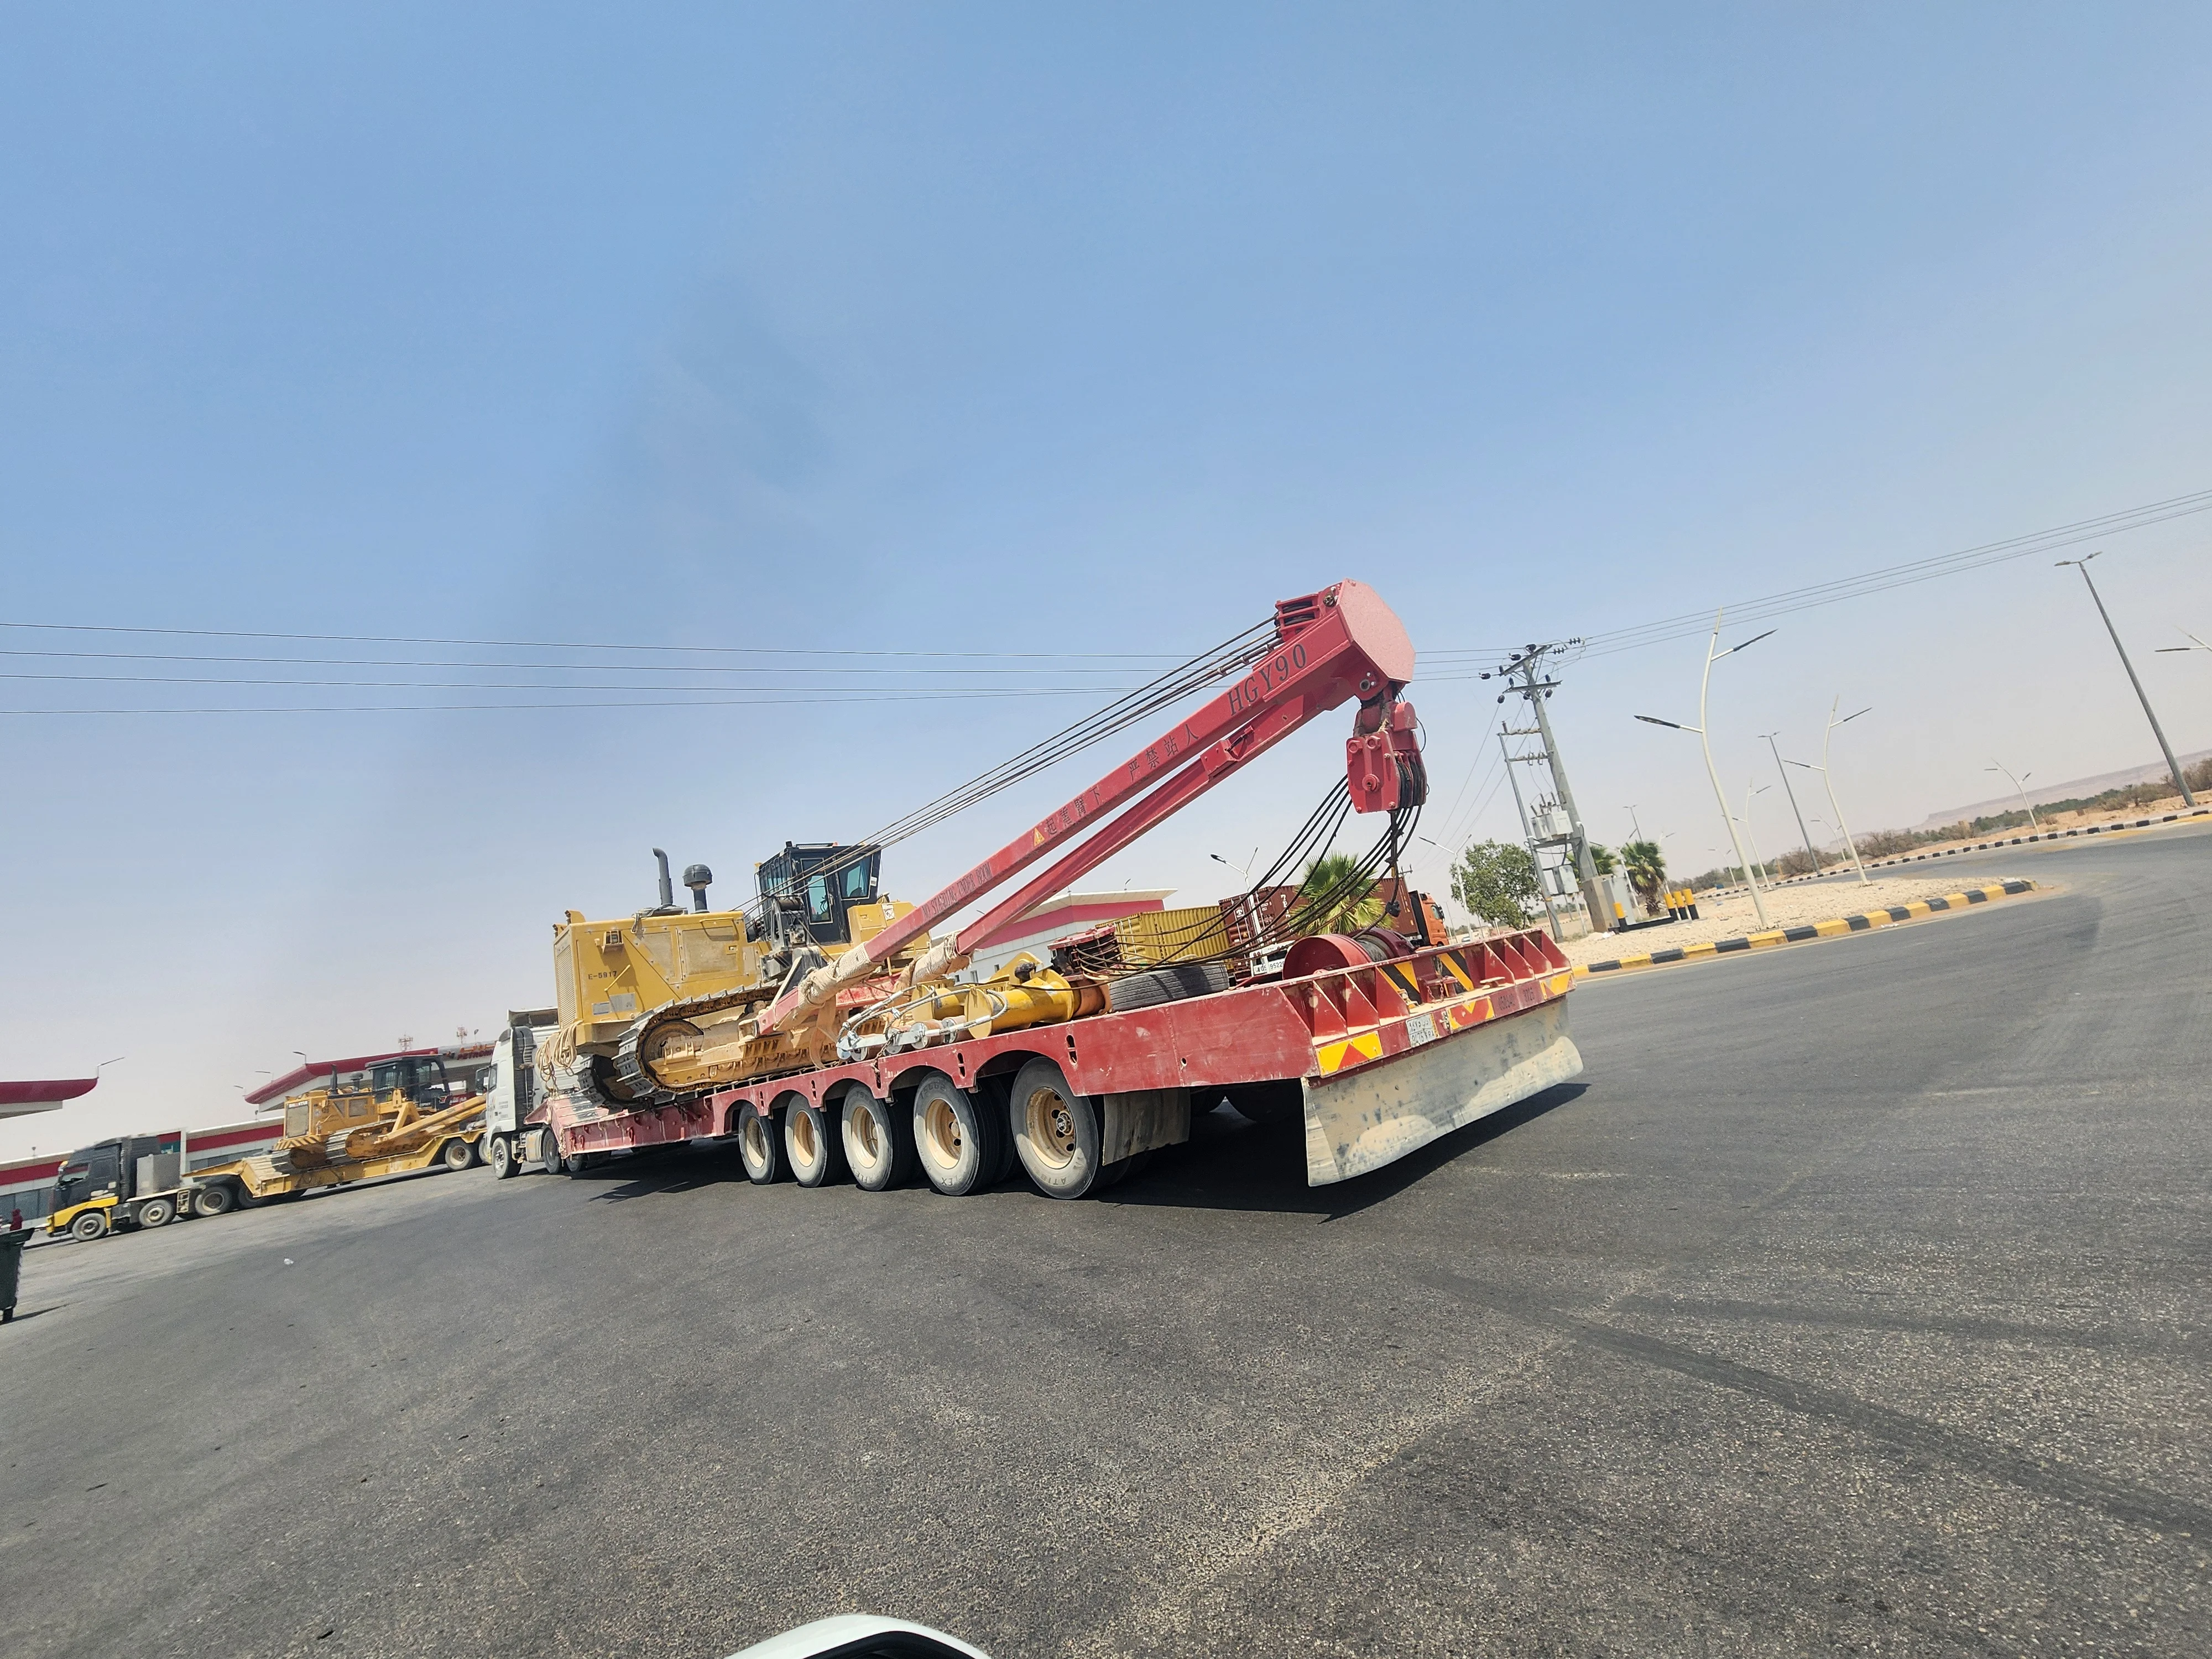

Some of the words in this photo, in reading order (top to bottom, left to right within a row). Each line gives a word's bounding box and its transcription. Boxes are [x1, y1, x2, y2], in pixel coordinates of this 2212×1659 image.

[1227, 644, 1306, 716] HGY90
[1128, 723, 1199, 782] 严禁站人
[588, 971, 617, 980] E-5917
